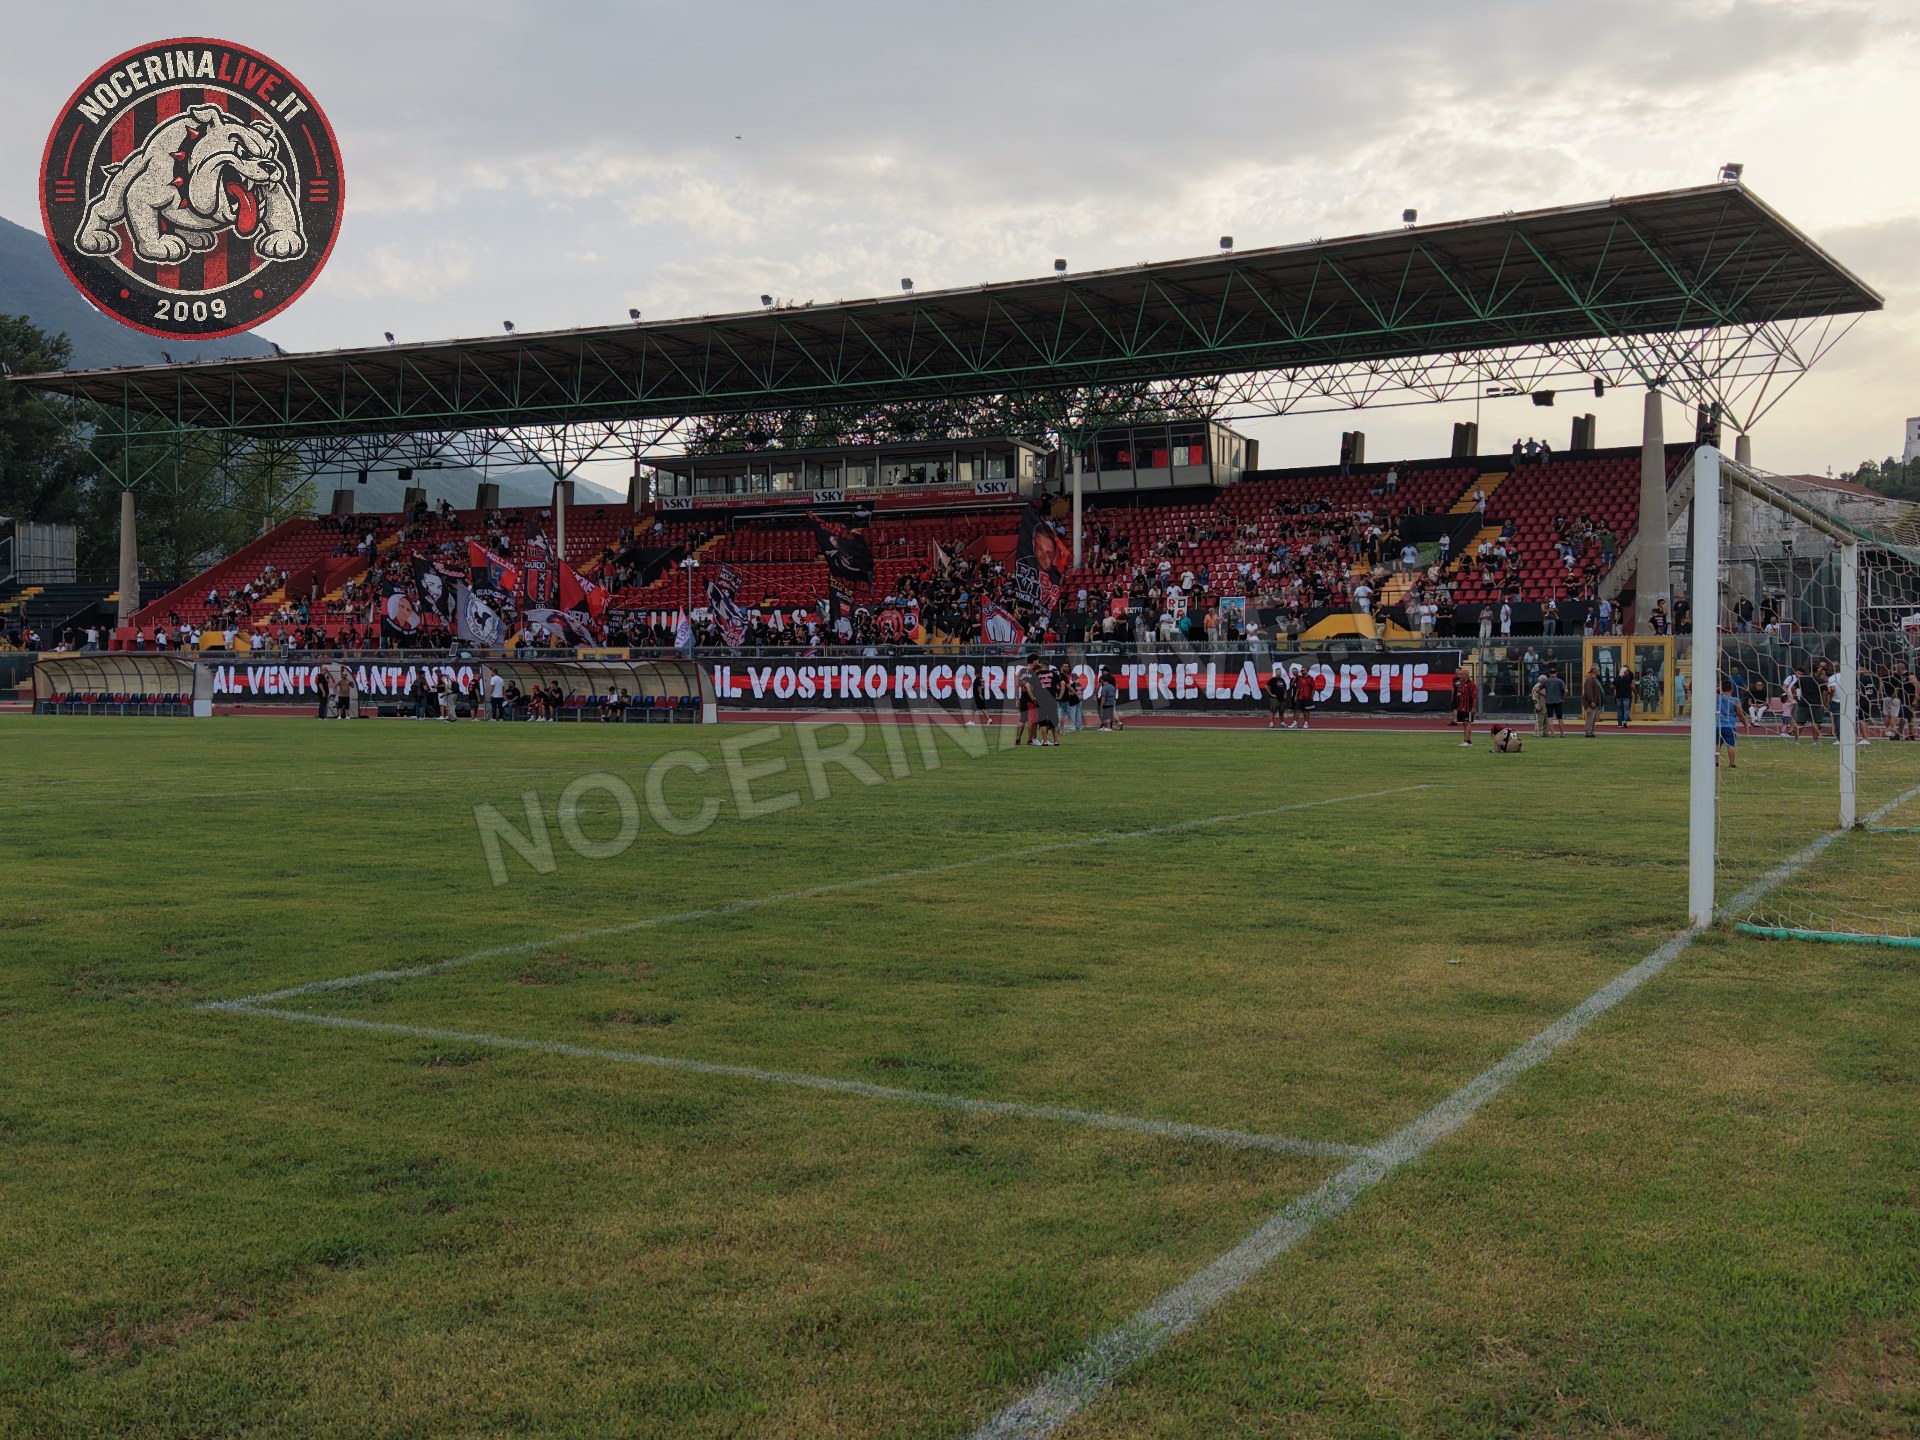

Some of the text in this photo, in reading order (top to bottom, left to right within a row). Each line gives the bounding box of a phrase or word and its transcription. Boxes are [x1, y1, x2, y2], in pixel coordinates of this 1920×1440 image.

[984, 482, 1008, 493] SKY
[821, 491, 843, 501] SKY
[670, 498, 690, 508] SKY
[213, 665, 243, 694] AL
[356, 665, 475, 696] ANTANDO
[714, 664, 742, 698] IL
[747, 664, 888, 699] VOSTRO
[1071, 663, 1198, 700] OTRE
[1206, 661, 1262, 700] LA
